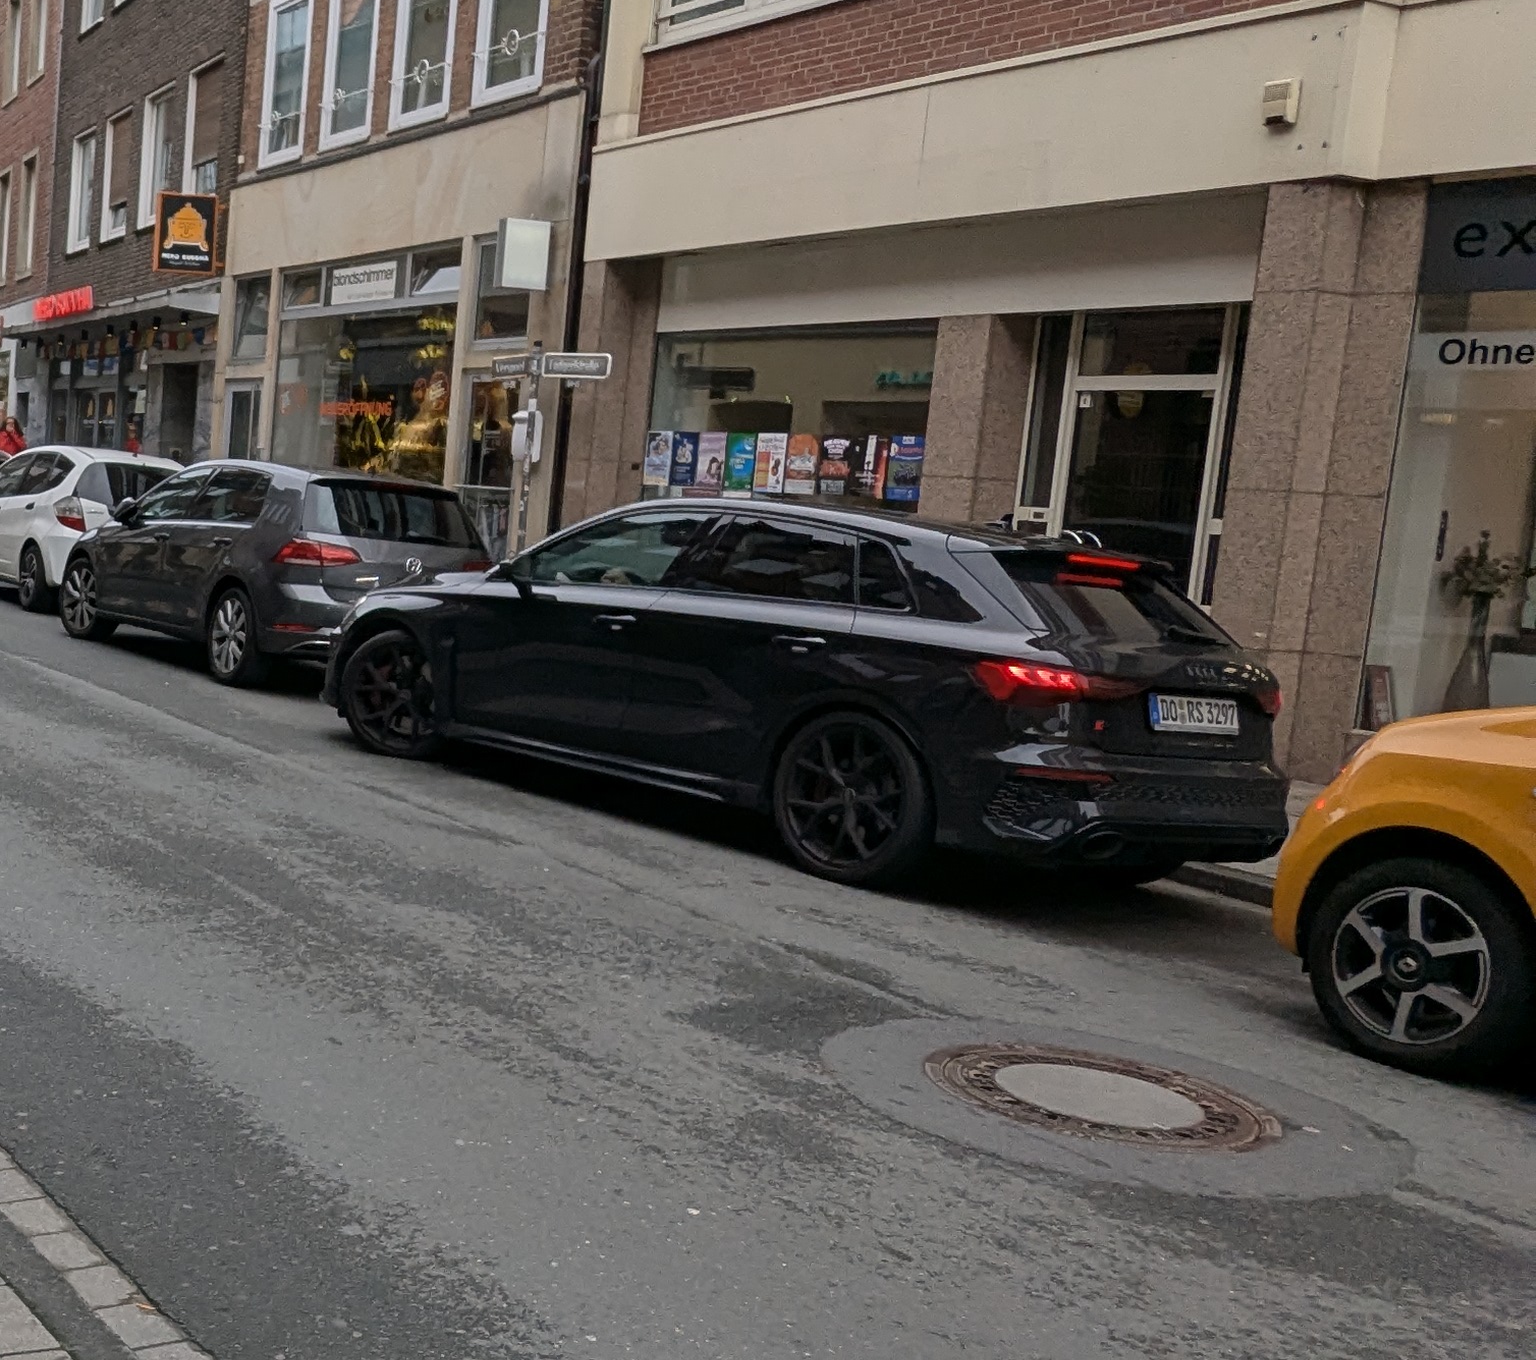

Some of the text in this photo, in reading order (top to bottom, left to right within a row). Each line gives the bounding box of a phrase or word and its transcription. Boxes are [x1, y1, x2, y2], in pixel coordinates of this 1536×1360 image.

[1438, 337, 1535, 365] Ohne
[1159, 698, 1236, 727] DO RS 3297
